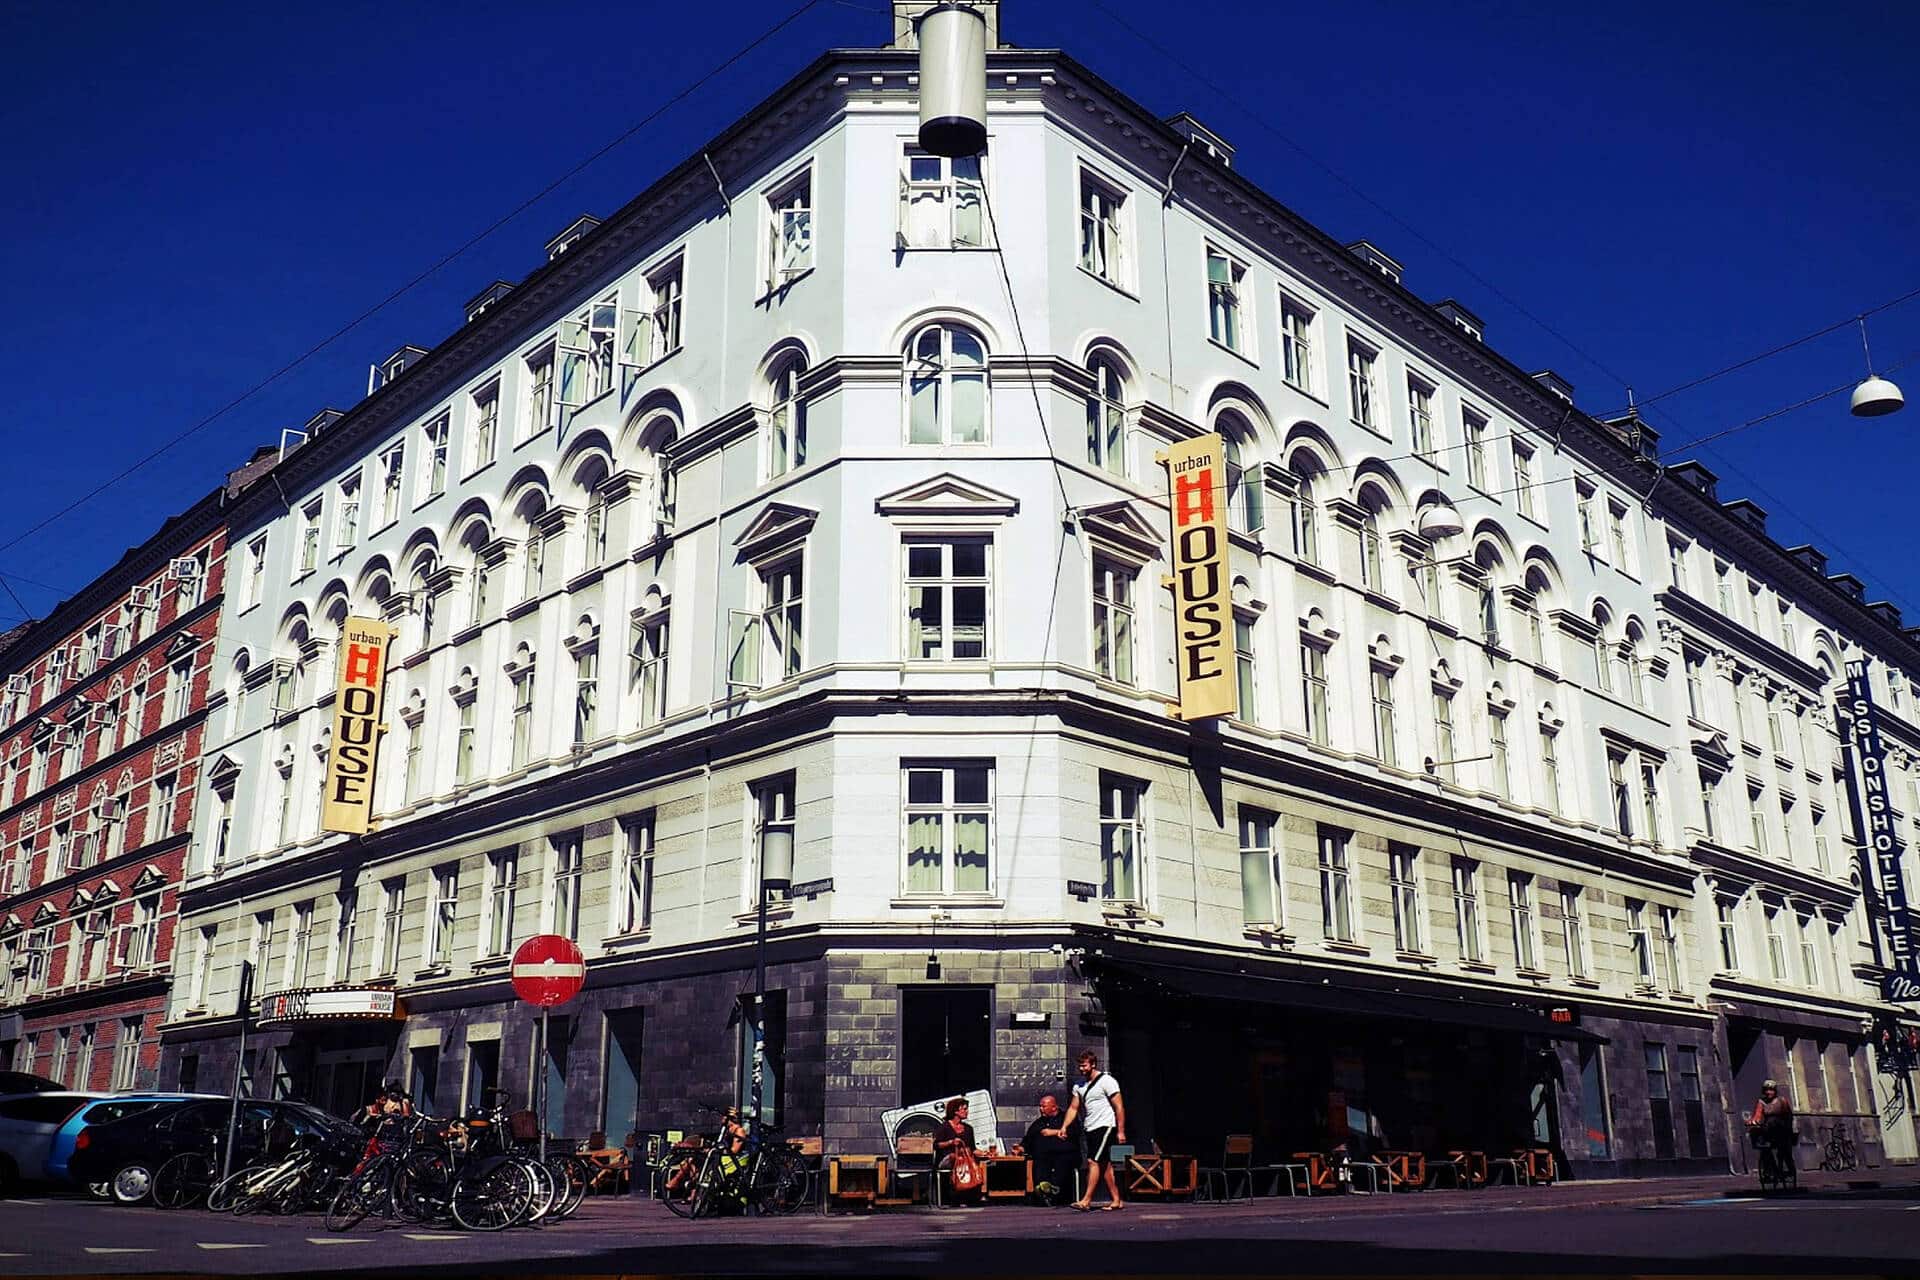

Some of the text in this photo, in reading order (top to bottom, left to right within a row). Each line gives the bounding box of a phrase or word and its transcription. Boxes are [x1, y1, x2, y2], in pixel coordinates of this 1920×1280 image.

[1174, 454, 1211, 474] urban
[349, 630, 382, 646] urban
[1175, 468, 1222, 682] HOUSE
[333, 643, 380, 805] HOUSE
[1845, 662, 1911, 972] MISSIONSHOTELLET
